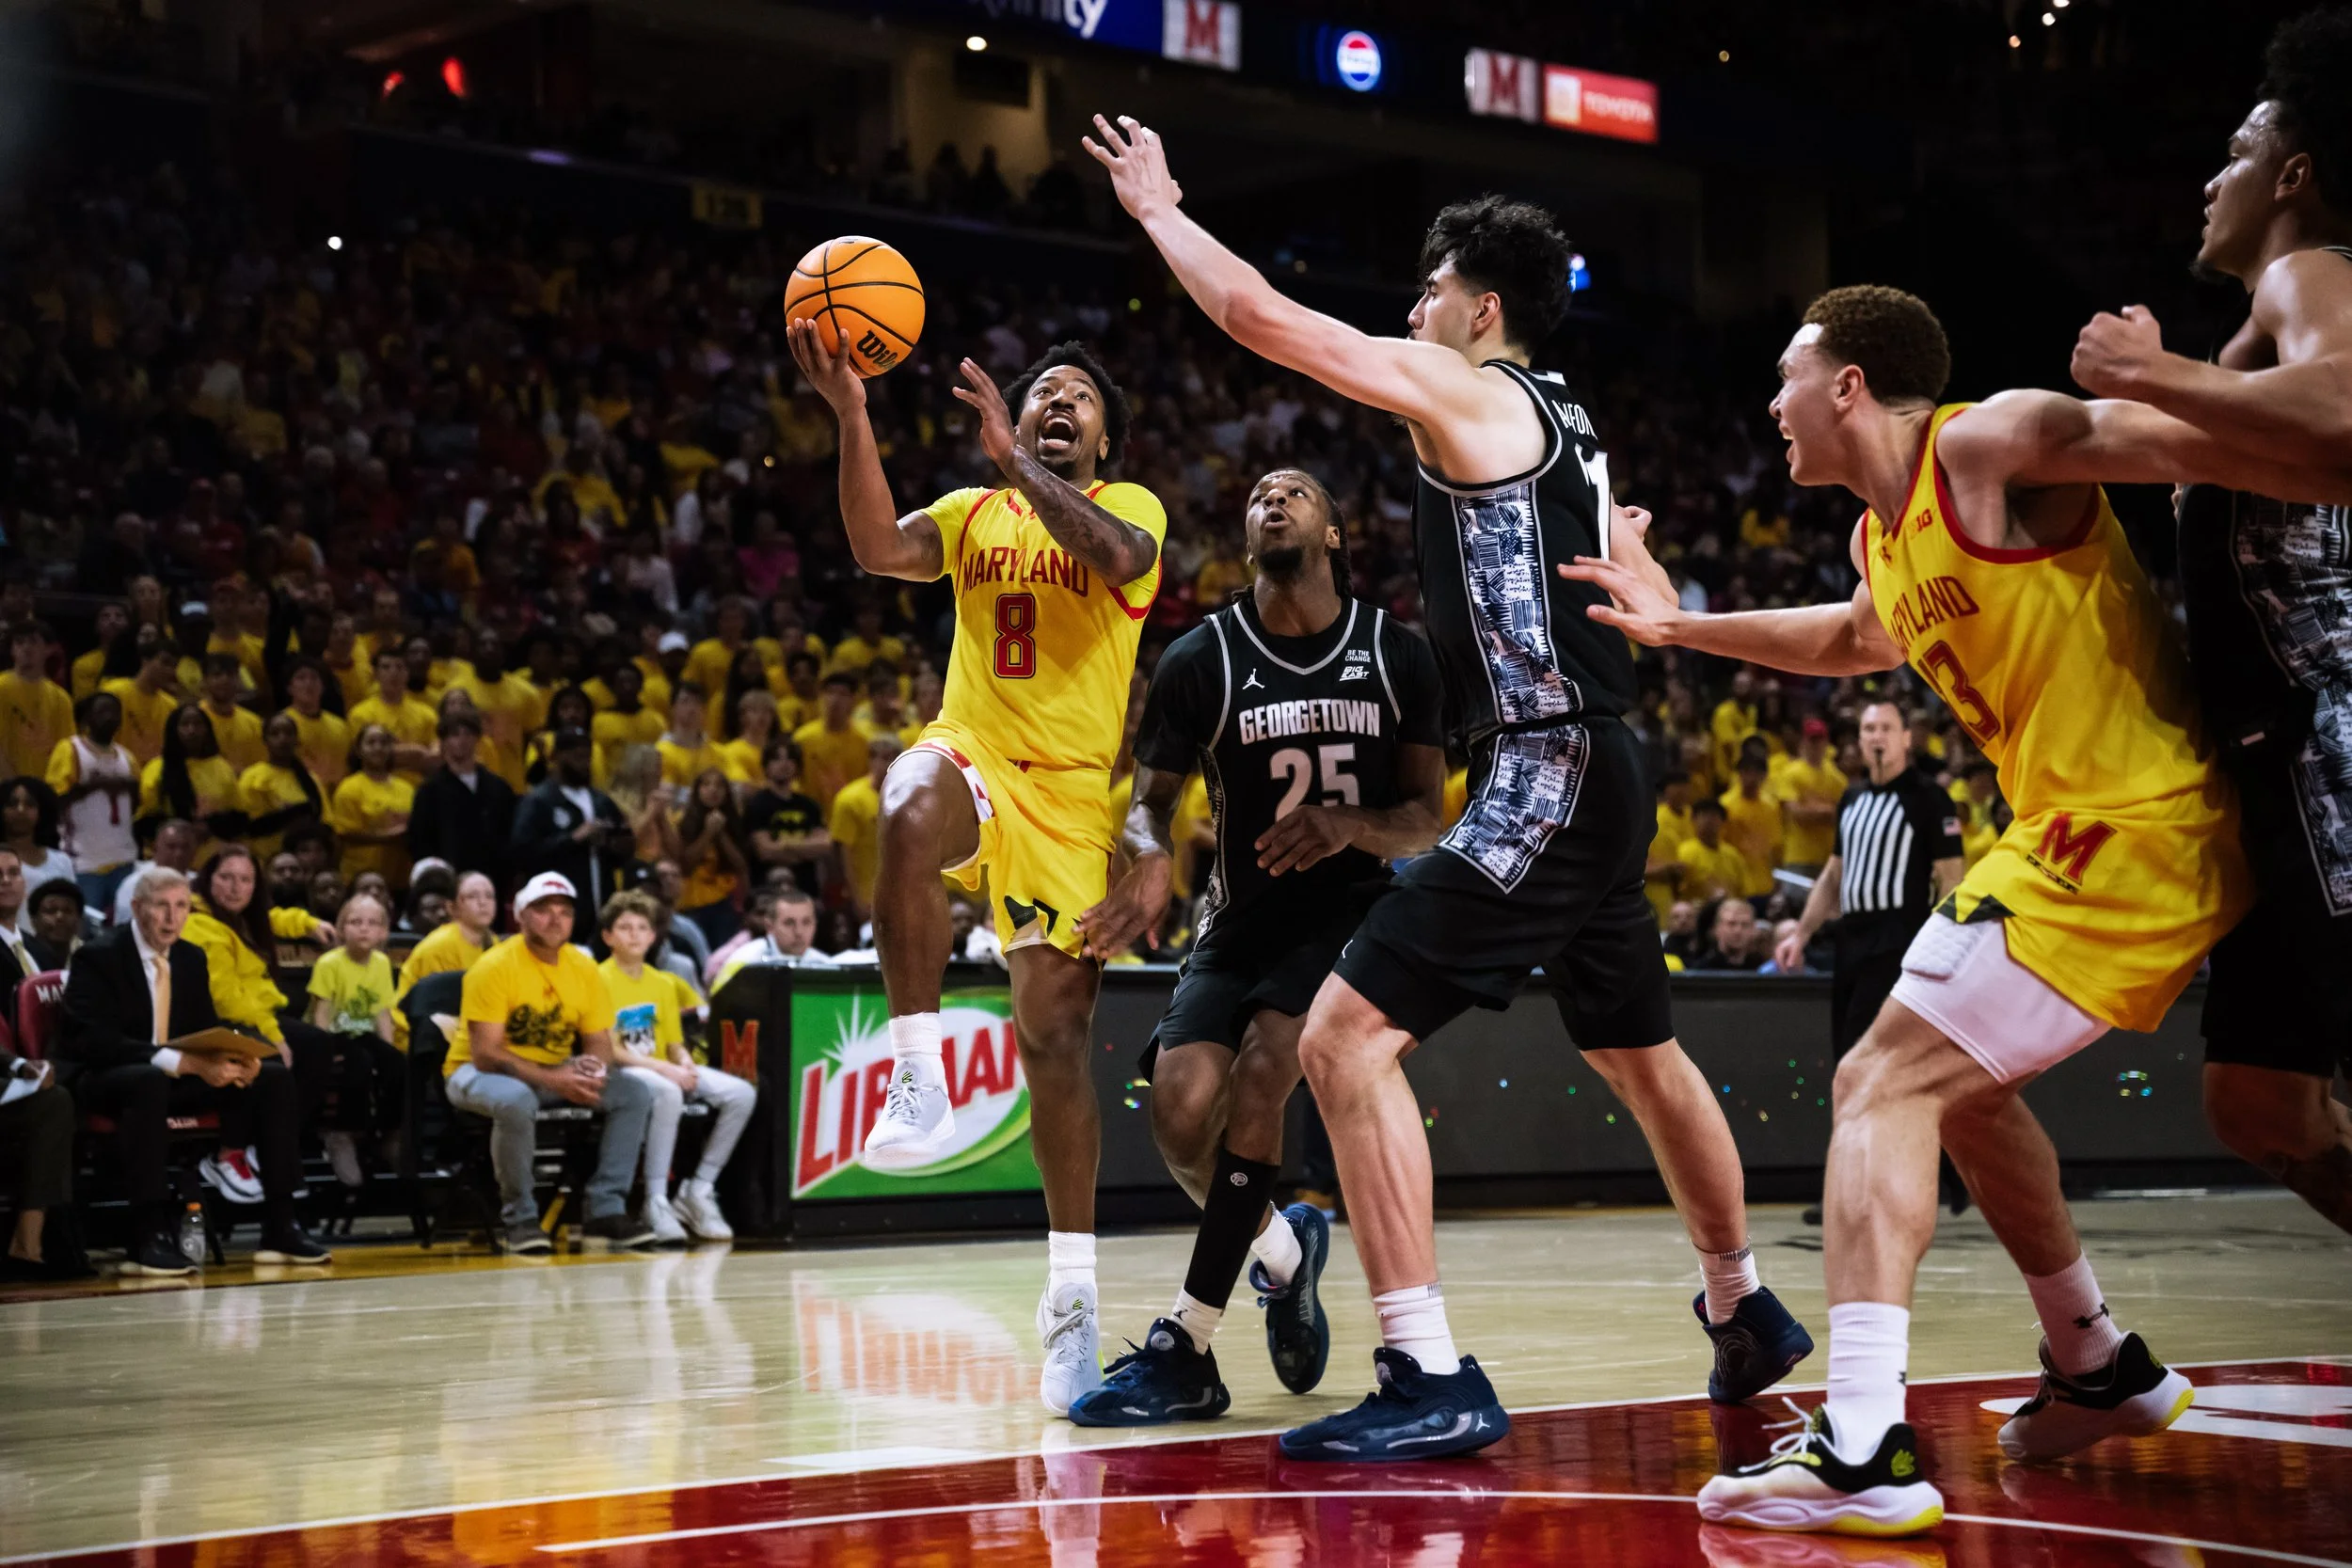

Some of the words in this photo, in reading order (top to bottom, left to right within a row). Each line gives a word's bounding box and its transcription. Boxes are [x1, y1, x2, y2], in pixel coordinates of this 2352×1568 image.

[1184, 1, 1220, 56] M
[1487, 52, 1520, 113] M
[994, 593, 1036, 679] 8
[1239, 698, 1380, 746] GEORGETOWN
[1270, 743, 1360, 821] 25
[2032, 812, 2118, 886] M
[721, 1019, 760, 1083] M
